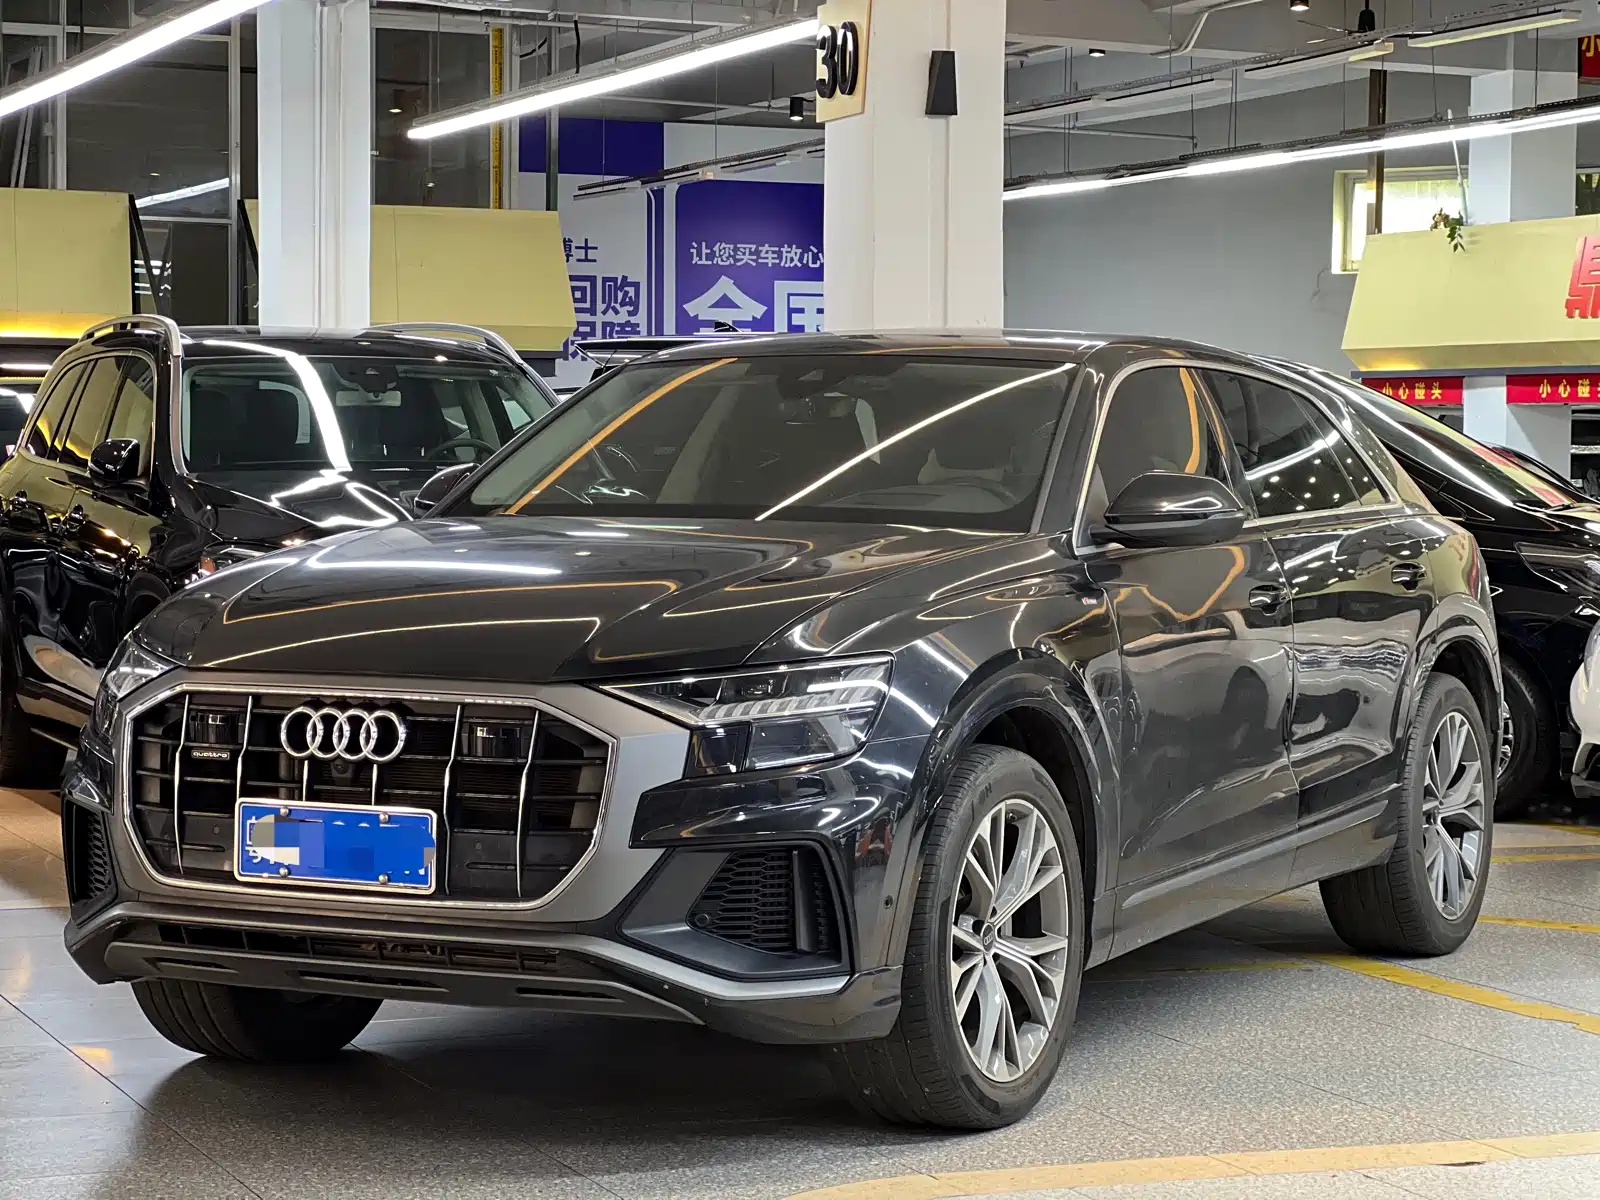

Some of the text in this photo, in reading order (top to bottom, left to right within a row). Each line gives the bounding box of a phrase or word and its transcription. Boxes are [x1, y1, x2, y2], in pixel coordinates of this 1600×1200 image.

[816, 21, 859, 98] 30
[689, 241, 825, 268] 让您买车放心
[569, 274, 641, 317] 回购
[1382, 381, 1443, 400] 小心碰头
[1538, 378, 1600, 398] 小心碰
